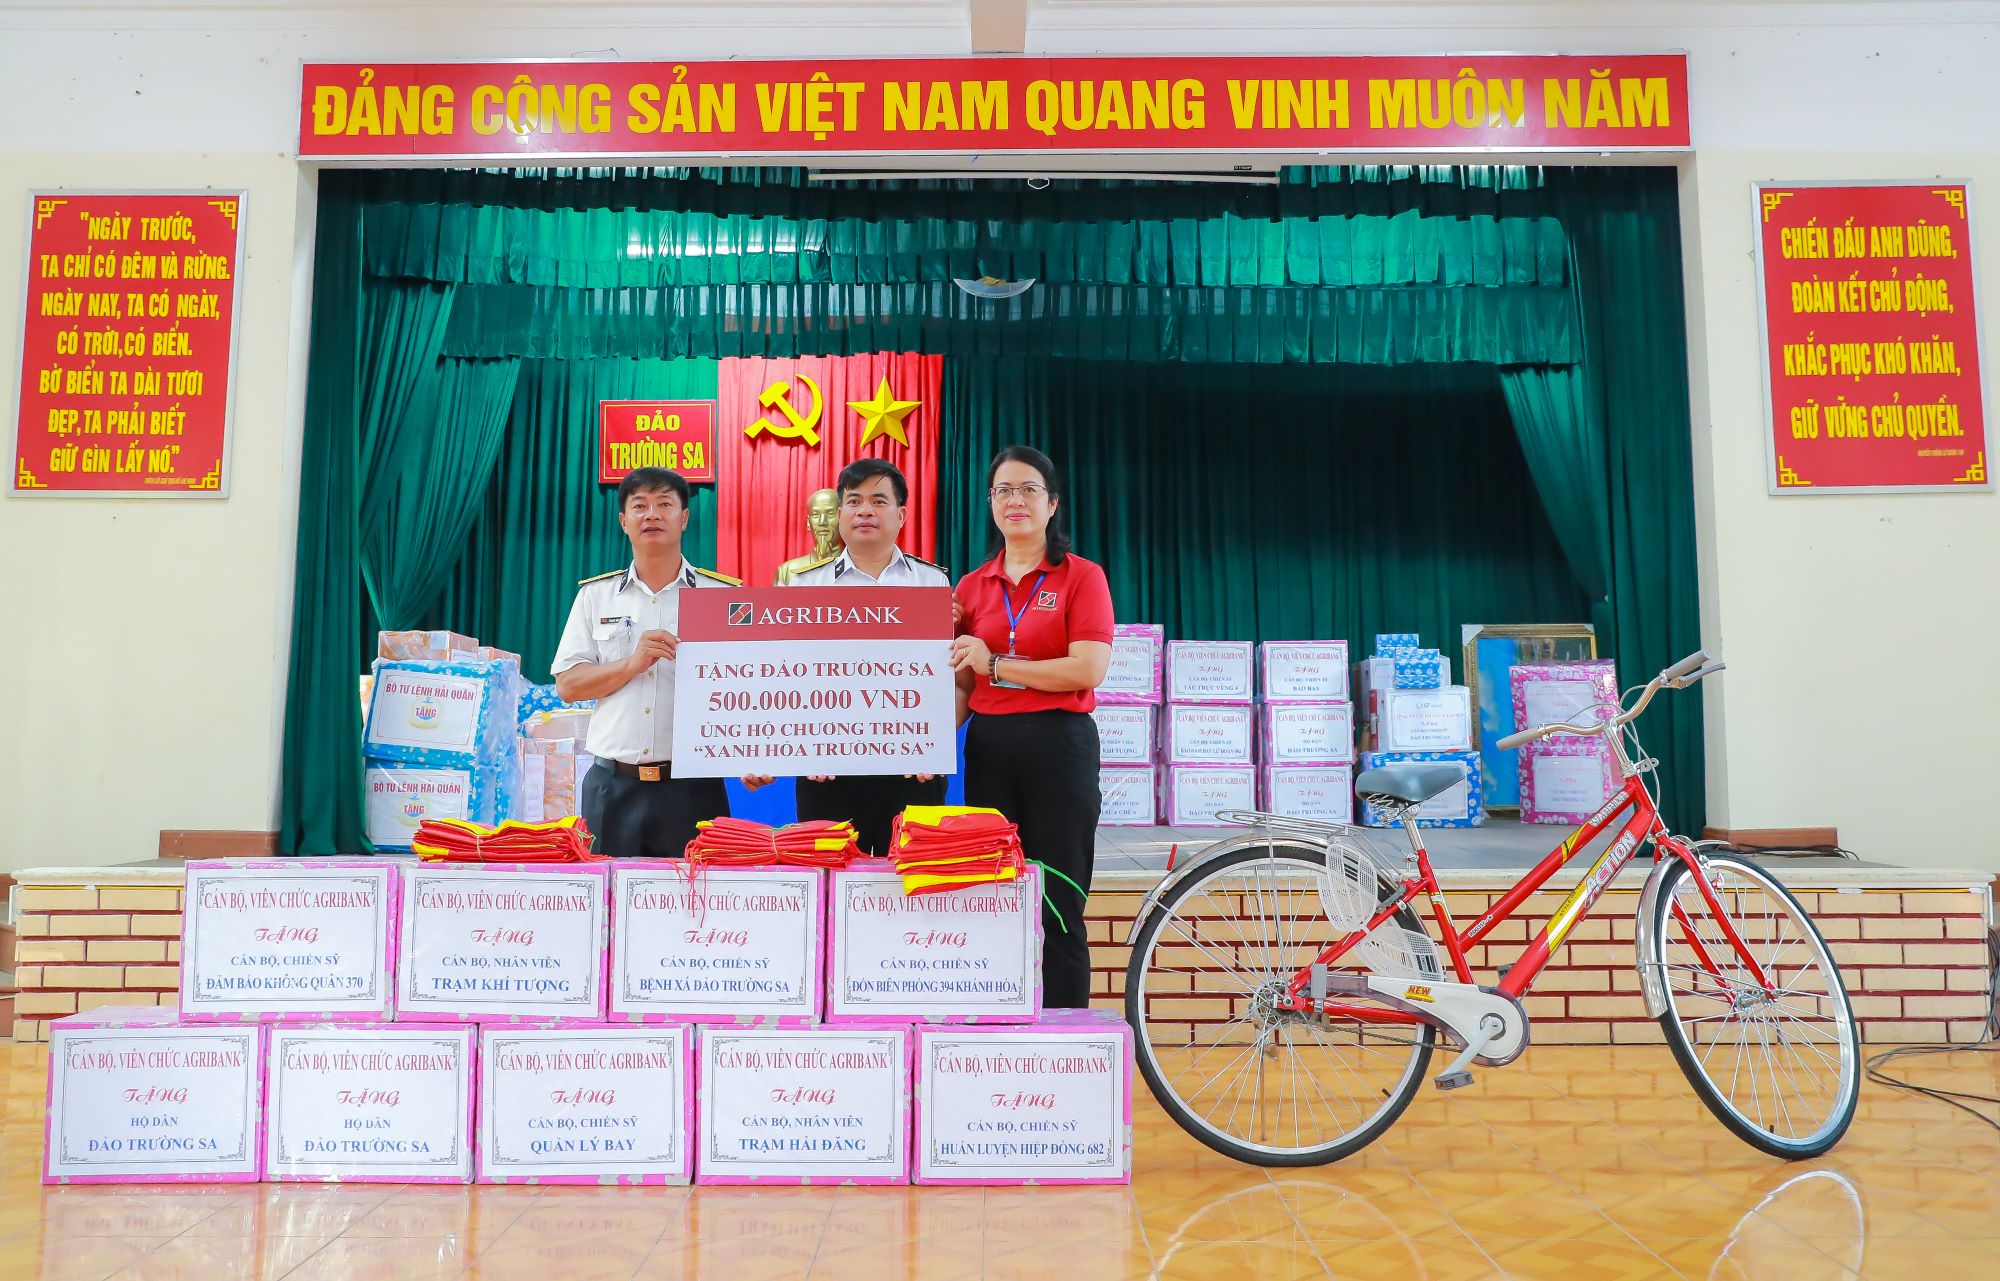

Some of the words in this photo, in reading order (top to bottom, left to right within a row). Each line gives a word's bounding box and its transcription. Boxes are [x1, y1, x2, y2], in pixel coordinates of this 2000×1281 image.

[312, 68, 454, 136] ĐẢNG
[471, 75, 610, 144] CỘNG
[627, 65, 736, 133] SẢN
[756, 72, 864, 141] VIỆT
[884, 78, 1009, 132] NAM
[1025, 79, 1205, 136] QUANG
[1226, 79, 1350, 129] VINH
[1369, 68, 1524, 129] MUÔN
[1543, 69, 1669, 128] NĂM
[141, 211, 195, 244] TRƯỚC,
[1781, 217, 1829, 259] CHIẾN
[1833, 217, 1865, 258] ĐẤU
[1871, 226, 1903, 257] ANH
[1907, 219, 1957, 258] DŨNG,
[41, 255, 59, 278] TA
[64, 245, 92, 277] CHỈ
[94, 250, 116, 278] CÓ
[121, 251, 156, 278] ĐÊM
[161, 251, 178, 279] VÀ
[184, 251, 230, 279] RỪNG.
[1792, 275, 1835, 313] ĐOÀN
[1838, 271, 1867, 312] KẾT
[1870, 267, 1901, 312] CHỦ
[1905, 273, 1953, 317] ĐỘNG,
[41, 288, 83, 316] NGÀY
[88, 293, 121, 319] NAY,
[127, 294, 144, 316] TA
[149, 288, 169, 317] CÓ
[176, 289, 220, 322] NGÀY,
[57, 325, 78, 355] CÓ
[152, 320, 192, 355] BIỂN.
[1784, 331, 1827, 376] KHẮC
[1830, 343, 1872, 382] PHỤC
[1874, 336, 1906, 374] KHÓ
[1910, 335, 1960, 376] KHĂN,
[40, 364, 62, 393] BỜ
[66, 359, 104, 394] BIỂN
[110, 371, 127, 395] TA
[134, 366, 160, 395] DÀI
[167, 370, 203, 395] TƯƠI
[107, 402, 145, 434] PHẢI
[150, 402, 186, 435] BIẾT
[636, 410, 680, 431] ĐẢO
[1791, 399, 1819, 439] GIỮ
[1824, 396, 1868, 438] VỮNG
[1871, 392, 1904, 437] CHỦ
[1906, 396, 1964, 440] QUYỀN.
[50, 443, 79, 472] GIỮ
[82, 444, 110, 472] GÌN
[116, 440, 145, 473] LẤY
[610, 436, 677, 469] TRƯỜNG
[683, 442, 704, 469] SA
[757, 606, 903, 625] AGRIBANK
[695, 662, 754, 681] TẶNG
[760, 658, 807, 678] ĐẢO
[813, 659, 903, 677] TRƯỜNG
[909, 662, 935, 677] SA
[708, 689, 852, 712] 500.000.000
[860, 689, 921, 709] VNĐ
[747, 721, 776, 740] HỘ
[780, 721, 864, 736] CHƯƠNG
[869, 718, 930, 735] TRÌNH
[694, 744, 759, 758] “XANH
[765, 741, 808, 758] HÓA
[813, 742, 896, 757] TRƯỜNG
[900, 742, 935, 756] SA”
[1585, 830, 1637, 894] ACTION
[422, 888, 444, 909] CÁN
[447, 891, 465, 914] BỘ,
[467, 889, 494, 911] VIÊN
[495, 890, 527, 911] CHỨC
[528, 895, 587, 912] AGRIBANK
[254, 925, 320, 945] TẶNG
[471, 927, 535, 946] TẶNG
[684, 928, 749, 947] TẶNG
[902, 929, 967, 948] TẶNG
[432, 977, 477, 992] TRẠM
[482, 976, 509, 991] KHÍ
[514, 979, 570, 994] TƯỢNG
[640, 977, 672, 994] BỆNH
[674, 976, 691, 991] XÁ
[694, 977, 719, 992] ĐẢO
[721, 976, 773, 993] TRƯỜNG
[775, 980, 789, 992] SA
[1408, 985, 1431, 996] NEW
[71, 1049, 95, 1070] CÁN
[99, 1050, 116, 1073] BỘ,
[119, 1048, 145, 1069] VIÊN
[148, 1047, 181, 1068] CHỨC
[182, 1051, 241, 1068] AGRIBANK
[719, 1047, 743, 1069] CÁN
[745, 1049, 763, 1072] BỘ,
[766, 1048, 792, 1069] VIÊN
[795, 1047, 828, 1069] CHỨC
[829, 1052, 888, 1069] AGRIBANK
[939, 1052, 962, 1074] CÁN
[965, 1055, 983, 1078] BỘ,
[986, 1052, 1013, 1074] VIÊN
[1014, 1053, 1047, 1074] CHỨC
[1049, 1057, 1108, 1074] AGRIBANK
[123, 1086, 188, 1105] TẶNG
[336, 1088, 401, 1107] TẶNG
[550, 1087, 616, 1107] TẶNG
[770, 1086, 836, 1106] TẶNG
[991, 1090, 1056, 1111] TẶNG
[131, 1116, 149, 1129] HỘ
[152, 1114, 178, 1127] DÂN
[88, 1136, 123, 1152] ĐẢO
[127, 1135, 195, 1151] TRƯỜNG
[198, 1137, 217, 1150] SA
[305, 1137, 337, 1152] ĐẢO
[341, 1137, 407, 1152] TRƯỜNG
[411, 1140, 430, 1152] SA
[530, 1137, 575, 1154] QUẢN
[579, 1136, 599, 1151] LÝ
[605, 1139, 636, 1151] BAY
[739, 1138, 784, 1153] TRẠM
[790, 1136, 817, 1151] HẢI
[822, 1136, 866, 1151] ĐĂNG
[977, 1142, 1018, 1158] LUYỆN
[1020, 1142, 1048, 1158] HIỆP
[1087, 1143, 1104, 1155] 682
